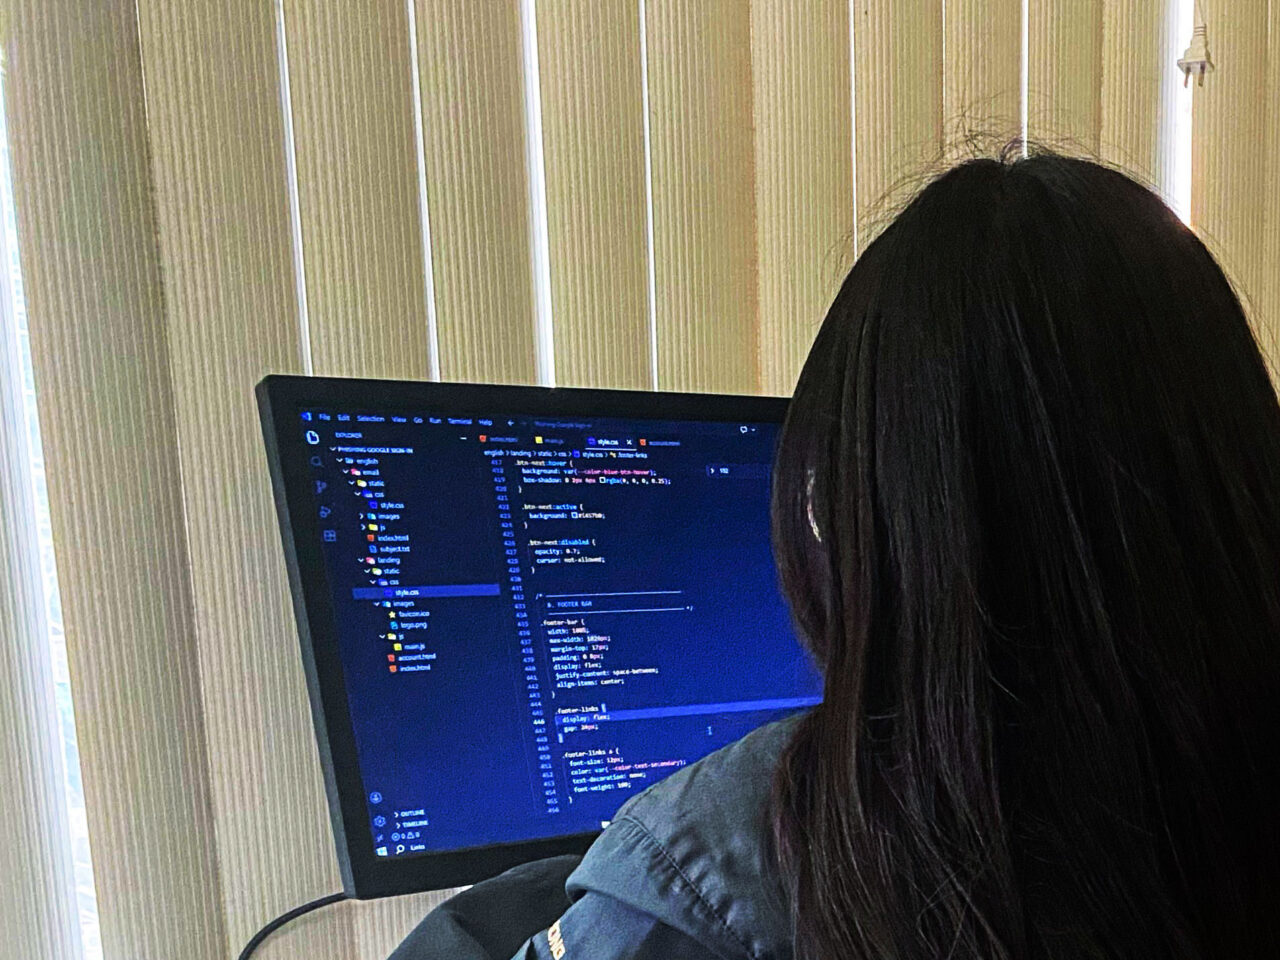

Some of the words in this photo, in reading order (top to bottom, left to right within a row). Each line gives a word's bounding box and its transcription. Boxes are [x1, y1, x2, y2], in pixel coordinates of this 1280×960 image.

[510, 450, 532, 458] landing
[357, 458, 378, 466] english
[380, 501, 404, 509] style.css
[378, 513, 400, 521] images
[377, 534, 409, 542] index.html
[377, 557, 400, 565] landing
[395, 589, 419, 597] style.css
[400, 621, 427, 630] logo.png
[398, 652, 436, 661] account.html
[400, 664, 431, 672] index.html
[553, 663, 582, 672] display:
[400, 808, 425, 818] OUTLINE
[402, 819, 429, 828] TIMELINE
